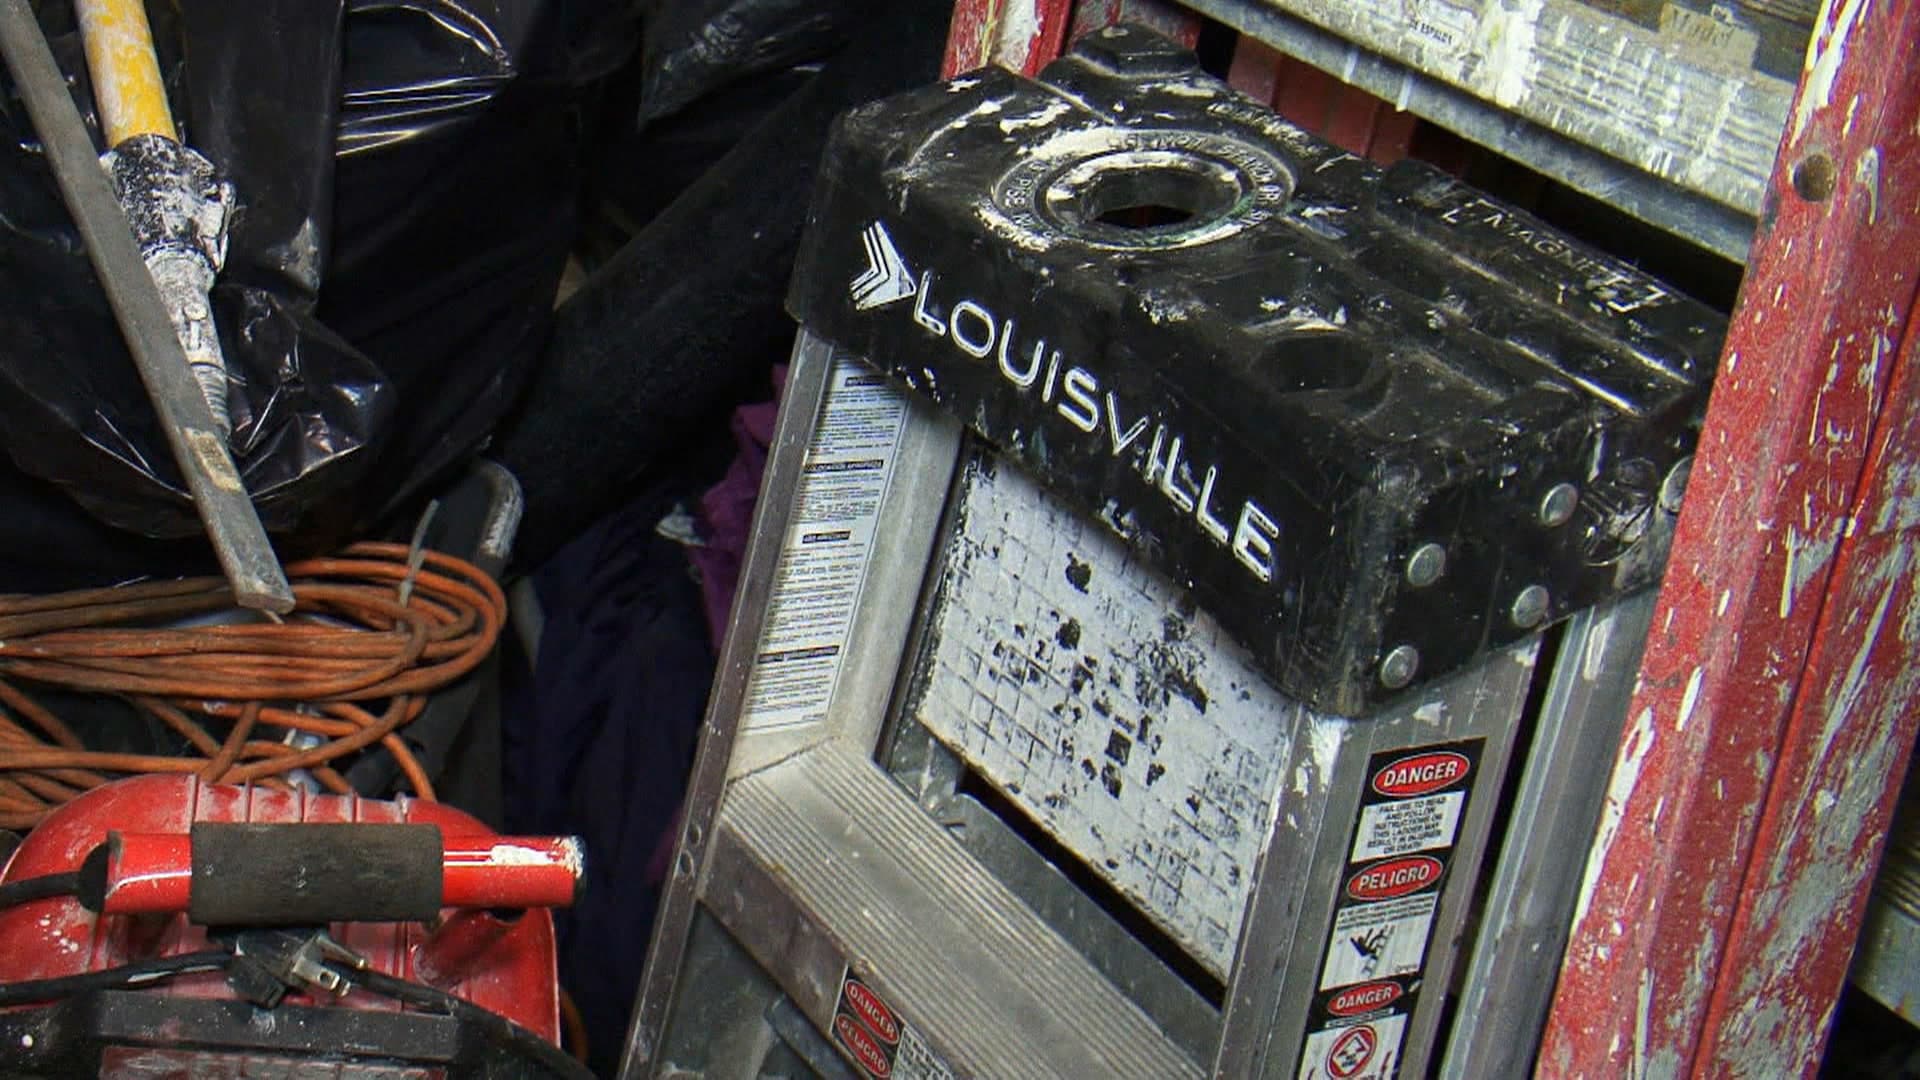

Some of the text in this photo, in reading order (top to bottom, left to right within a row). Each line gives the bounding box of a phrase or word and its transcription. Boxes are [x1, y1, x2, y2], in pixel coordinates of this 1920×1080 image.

[914, 270, 1280, 584] LOUISVILLE
[1383, 760, 1458, 787] DANGER
[1358, 863, 1430, 891] PELIGRO
[849, 984, 896, 1038] DANGER
[1335, 986, 1393, 1010] DANGER
[840, 1020, 887, 1072] PELIGRO
